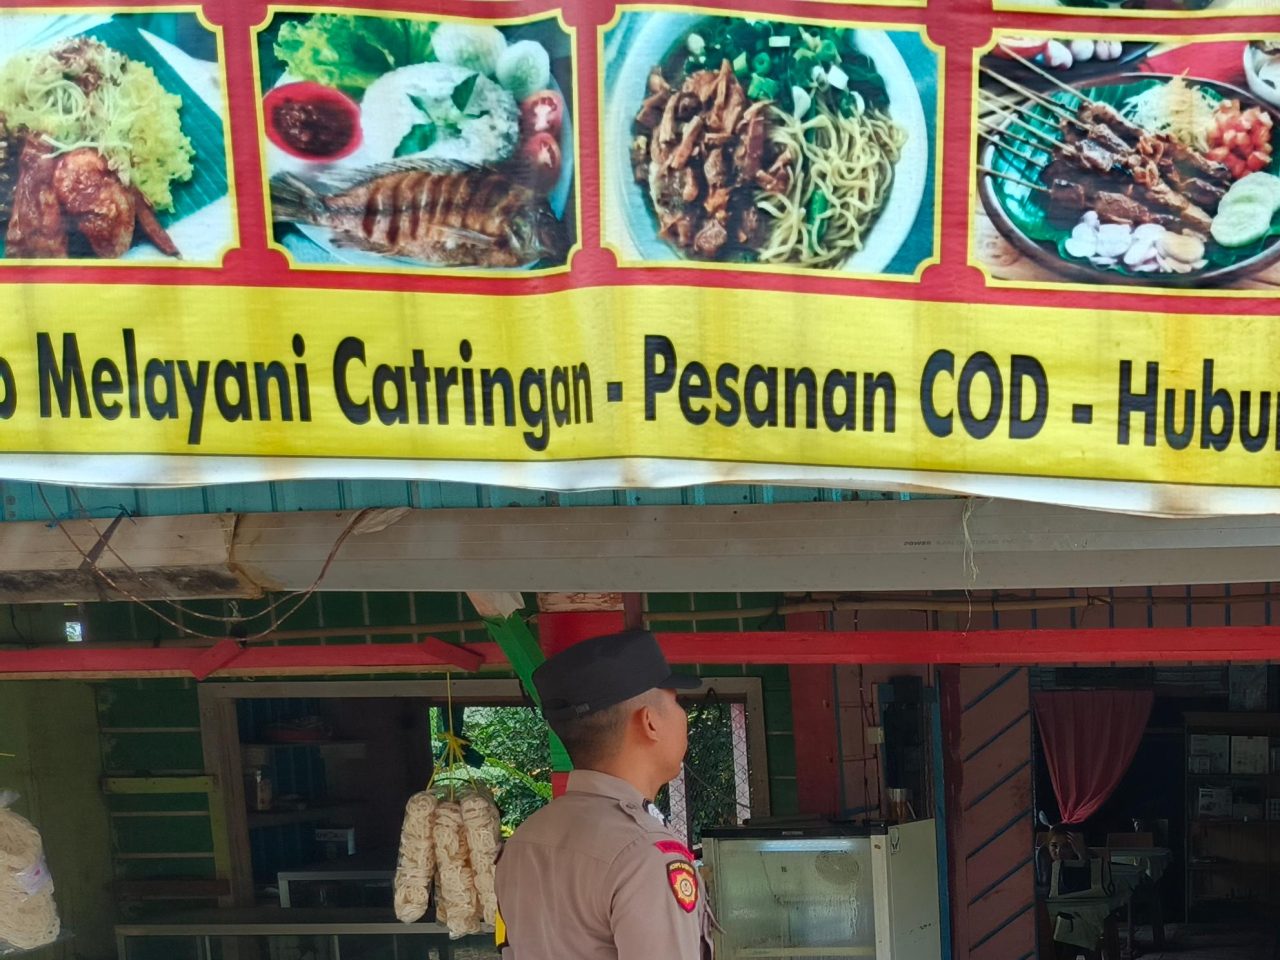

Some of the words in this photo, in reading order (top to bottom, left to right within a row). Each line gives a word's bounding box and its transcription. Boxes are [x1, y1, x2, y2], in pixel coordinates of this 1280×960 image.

[36, 328, 312, 445] Melayani
[332, 336, 594, 452] Catringan
[643, 334, 897, 433] Pesanan
[920, 348, 1049, 440] COD
